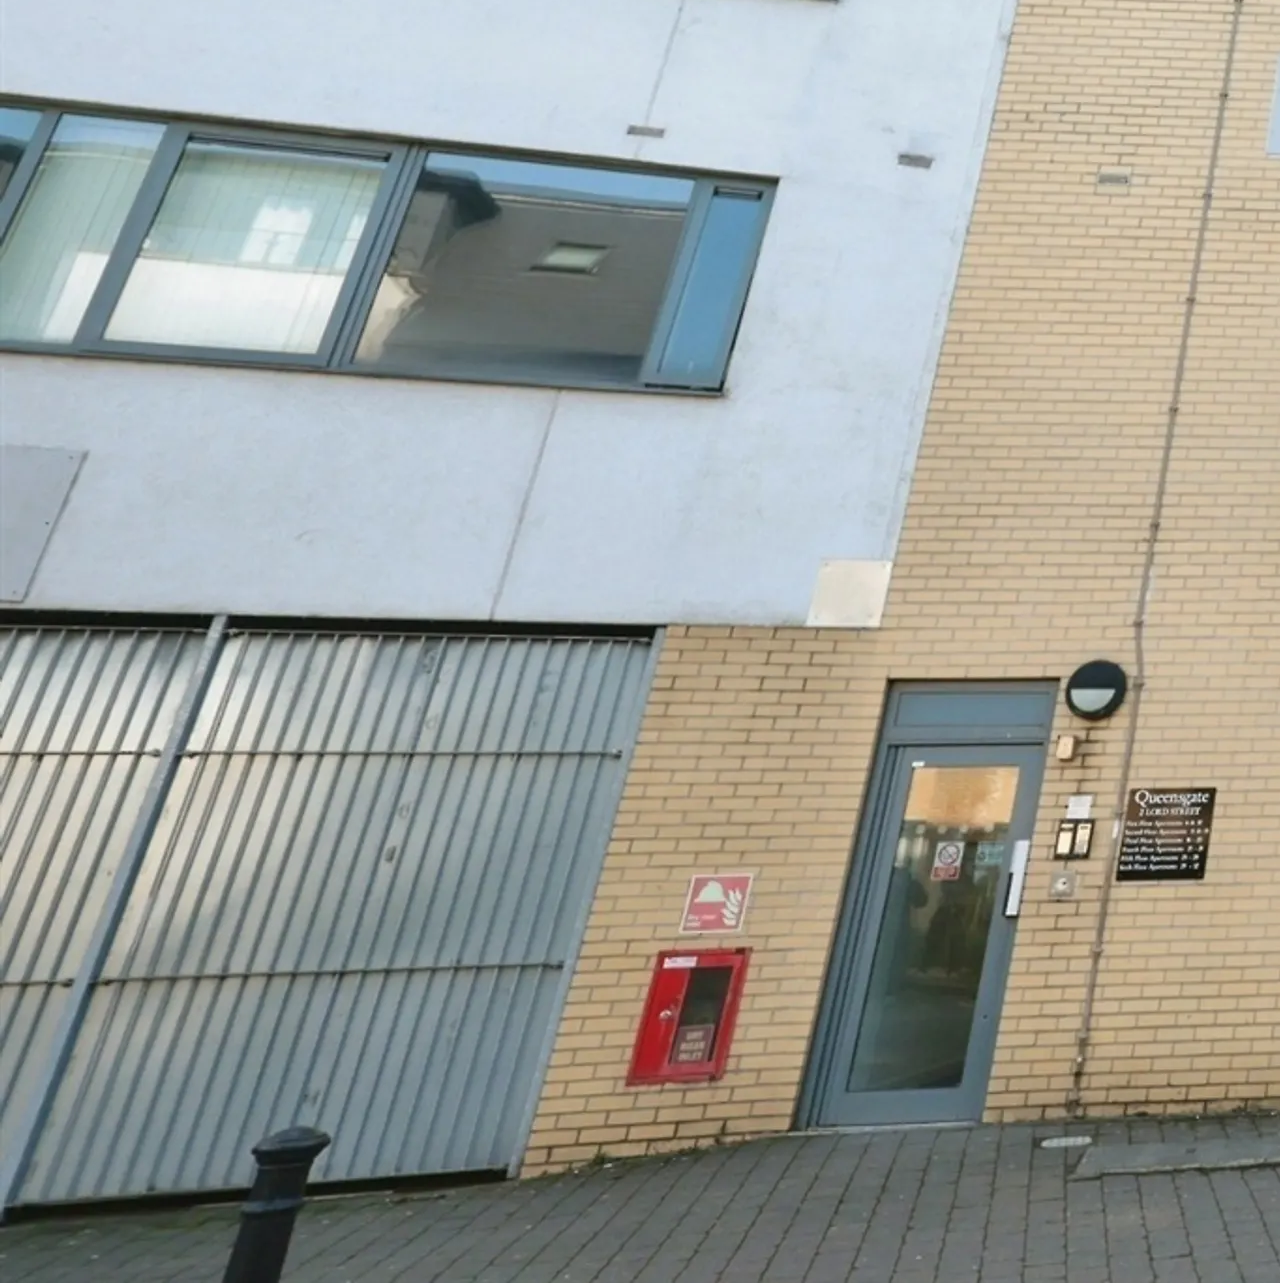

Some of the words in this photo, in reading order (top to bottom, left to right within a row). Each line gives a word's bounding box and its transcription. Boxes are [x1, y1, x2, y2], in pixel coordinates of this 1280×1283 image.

[1135, 790, 1209, 808] Queensgate
[1145, 807, 1169, 816] LORD
[1170, 806, 1201, 816] STREET
